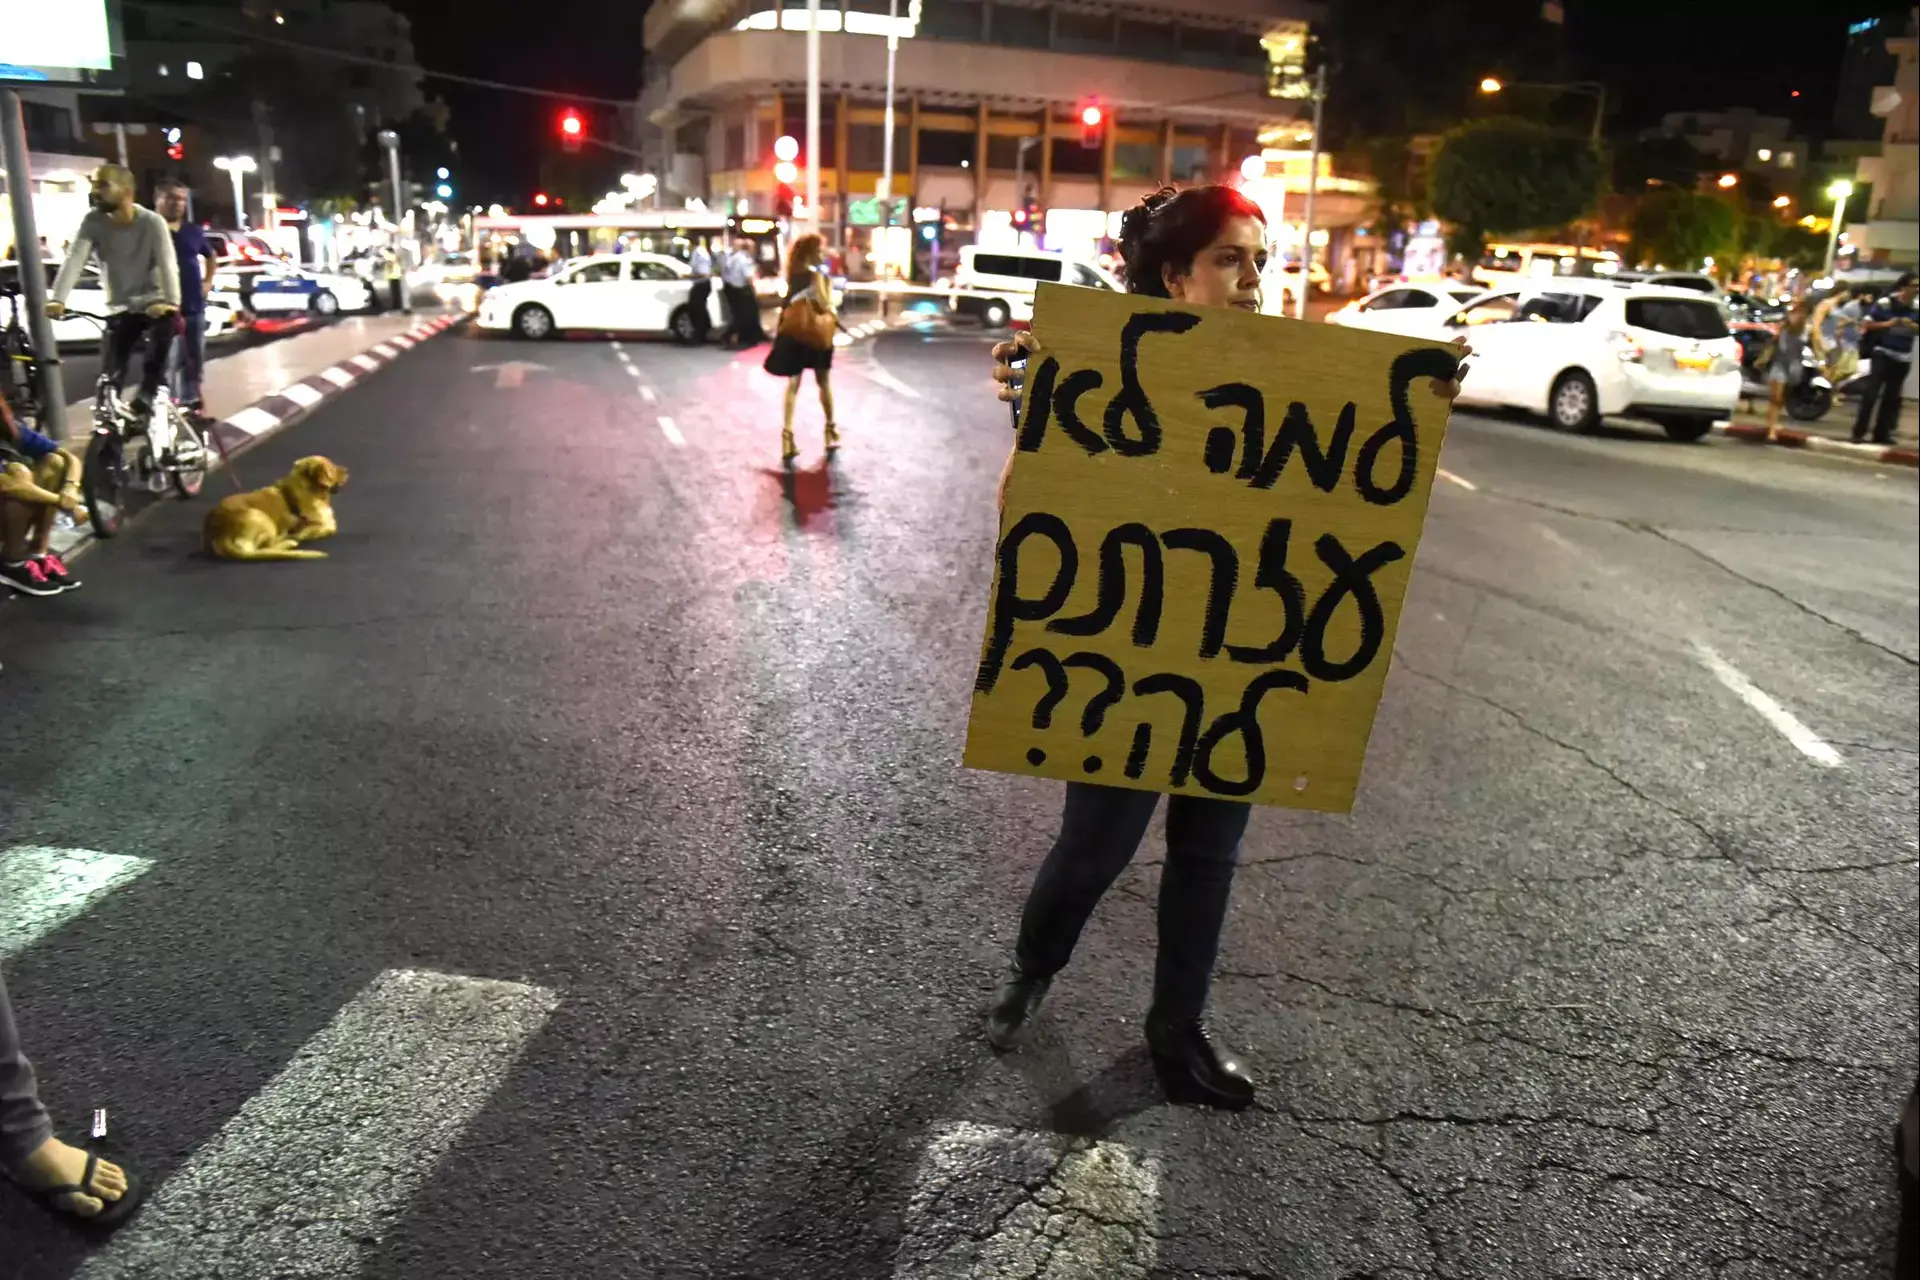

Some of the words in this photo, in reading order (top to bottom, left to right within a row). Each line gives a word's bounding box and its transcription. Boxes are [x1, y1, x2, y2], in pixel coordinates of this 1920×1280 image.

[1018, 311, 1202, 457] לא
[1195, 348, 1459, 505] למה
[974, 512, 1405, 695] עזרתם
